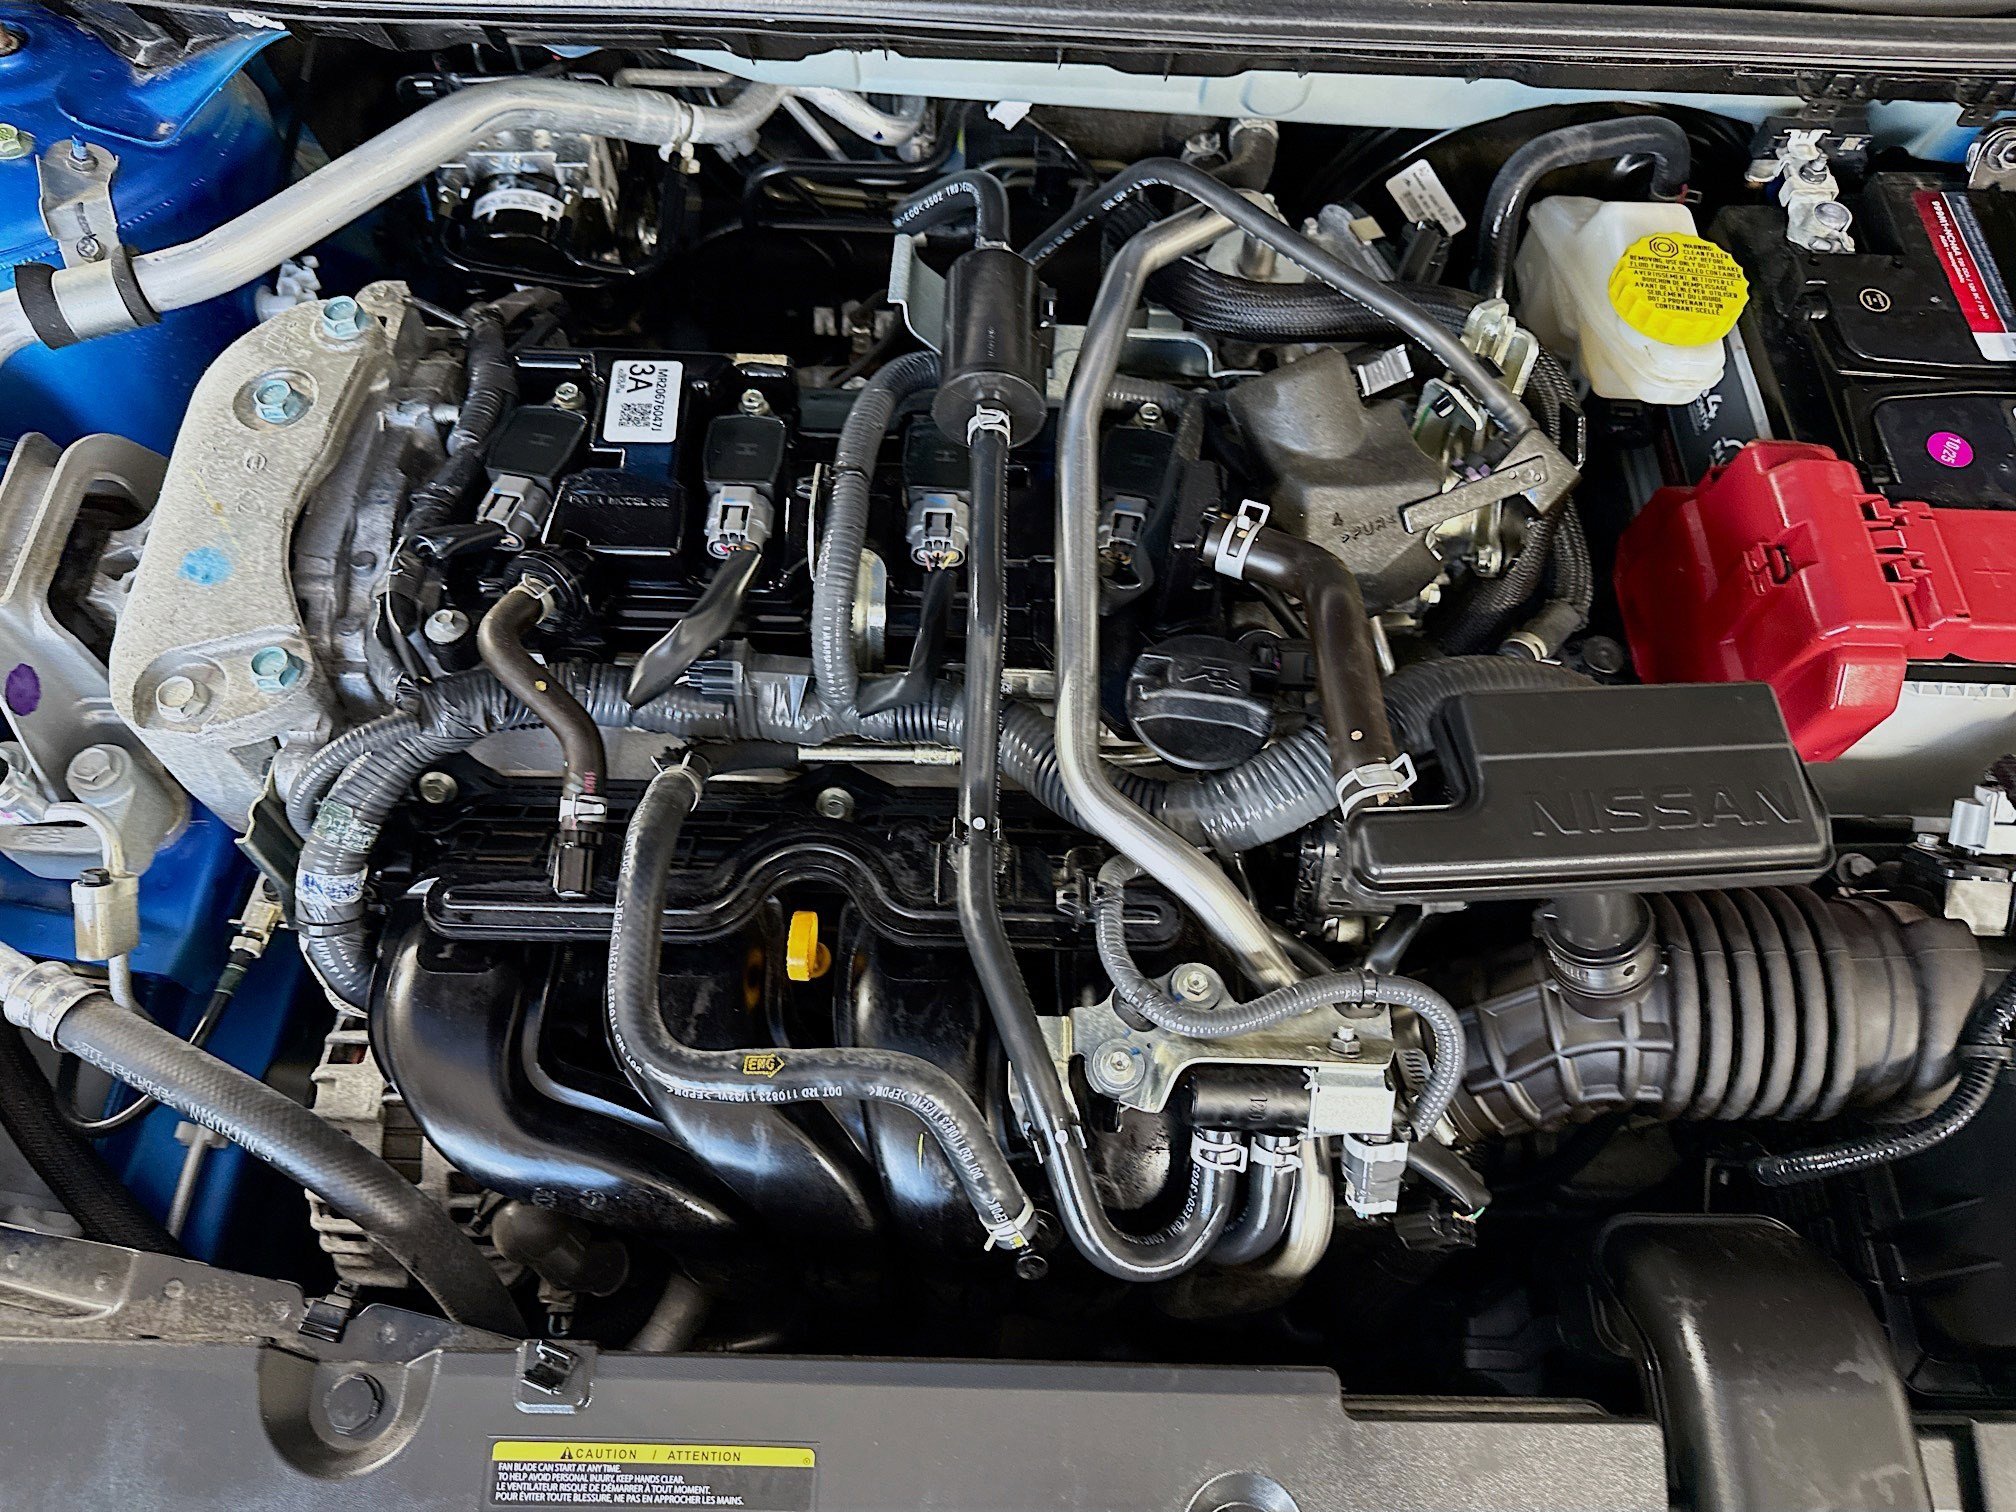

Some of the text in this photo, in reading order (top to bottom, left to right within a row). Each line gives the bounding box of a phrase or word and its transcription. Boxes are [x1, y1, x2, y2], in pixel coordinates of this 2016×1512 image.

[1682, 243, 1713, 251] WARNING:
[1678, 266, 1704, 274] SEALED
[1706, 269, 1741, 278] CONTAINER
[1642, 276, 1670, 284] BOUCHON
[1683, 282, 1727, 291] REMPLISSAGE
[1692, 276, 1725, 285] NETTOYER
[1647, 289, 1685, 298] SEULEMENT
[1709, 290, 1737, 299] UTILISER
[1655, 303, 1693, 312] CONTENANT
[1668, 298, 1706, 306] PROVENANT
[626, 363, 656, 393] 3A
[1940, 436, 1962, 464] 10/25
[1524, 780, 1802, 836] NISSAN
[607, 987, 618, 1031] 110823
[625, 1054, 644, 1075] DOT
[748, 1057, 777, 1071] ENG
[758, 1087, 799, 1103] 110823
[822, 1085, 843, 1098] DOT
[189, 1102, 260, 1153] NICHIRIN
[937, 1116, 966, 1148] 110823
[967, 1157, 985, 1180] DOT
[576, 1448, 637, 1460] CAUTION
[667, 1450, 741, 1462] ATTENTION
[498, 1462, 514, 1472] FAN
[514, 1463, 538, 1472] BLADE
[537, 1463, 556, 1472] CAN
[555, 1464, 577, 1473] START
[577, 1464, 586, 1473] AT
[587, 1464, 602, 1473] ANY
[498, 1472, 509, 1481] TO
[508, 1473, 528, 1482] HELP
[528, 1473, 551, 1482] AVOID
[552, 1473, 589, 1482] PERSONAL
[589, 1474, 616, 1483] INJURY,
[616, 1474, 634, 1483] KEEP
[634, 1475, 661, 1483] HANDS
[496, 1482, 711, 1495] LE VENTILATEUR RISQUE DE DÉMARRER À TOUT MOMENT.
[495, 1491, 519, 1501] POUR
[519, 1491, 546, 1502] ÉVITER
[546, 1492, 572, 1502] TOUTE
[572, 1493, 613, 1504] BLESSURE,
[613, 1495, 625, 1503] NE
[625, 1495, 641, 1503] PAS
[653, 1495, 701, 1504] APPROCHER
[701, 1496, 716, 1505] LES
[716, 1496, 745, 1506] MAINS.
